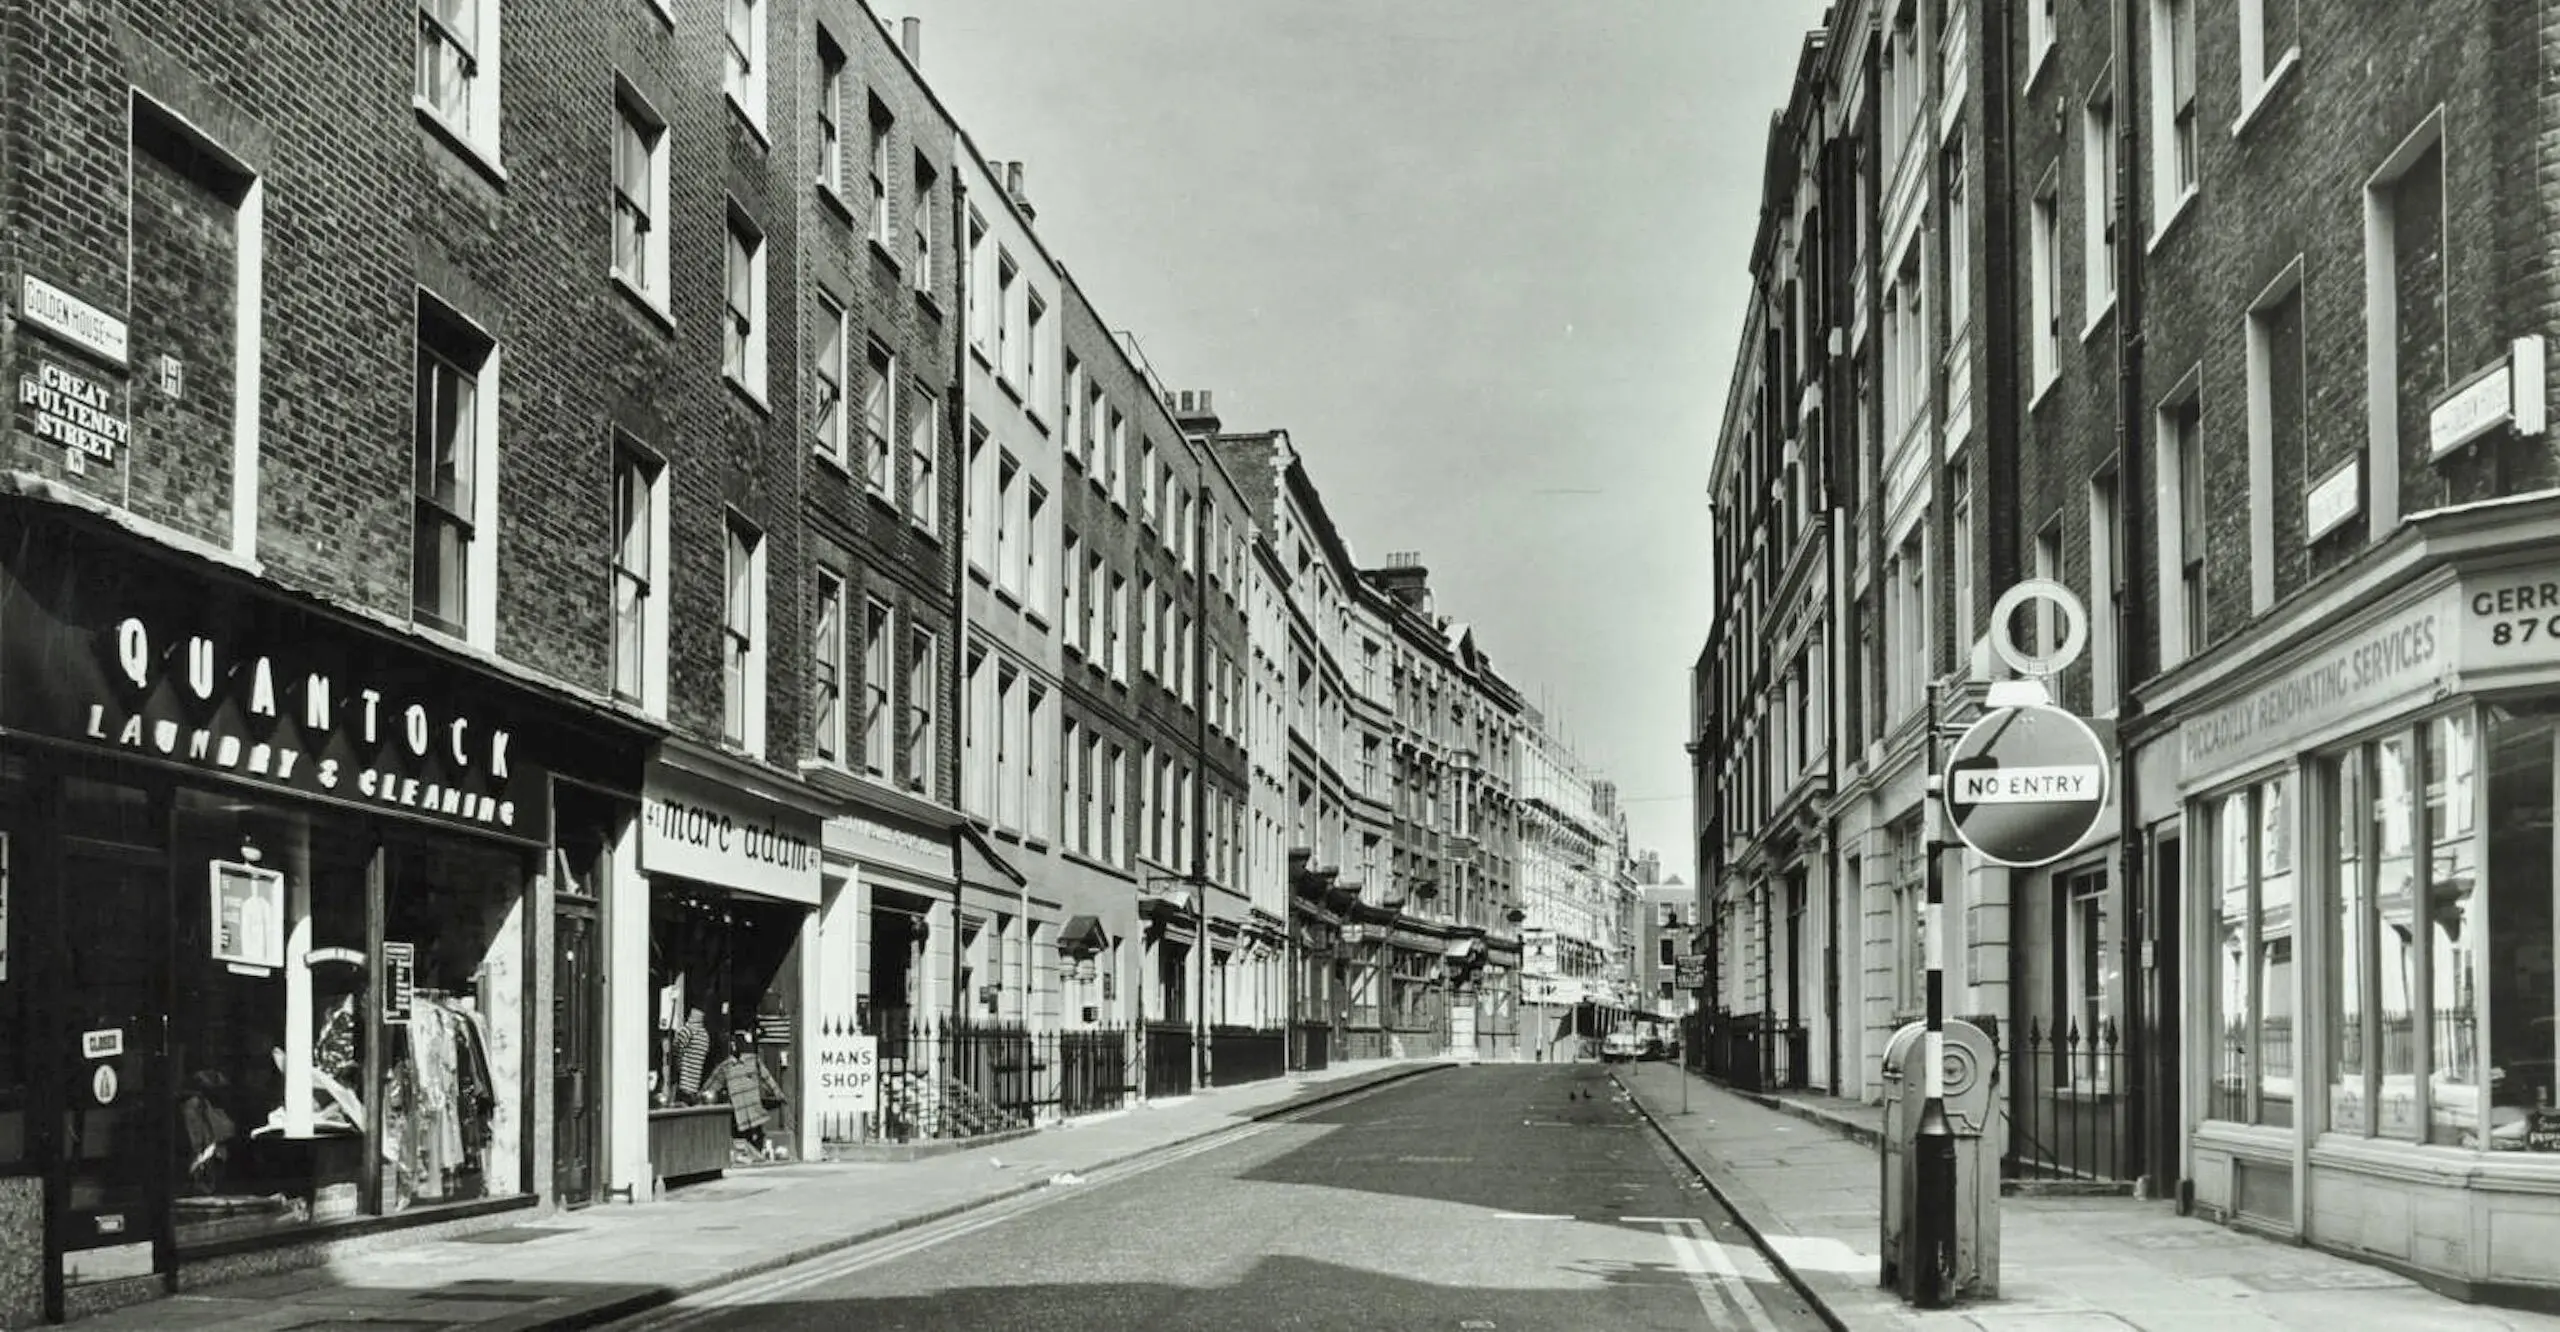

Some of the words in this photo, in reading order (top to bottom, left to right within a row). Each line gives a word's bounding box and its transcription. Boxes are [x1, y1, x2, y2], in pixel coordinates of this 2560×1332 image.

[27, 280, 69, 326] GOLDEN
[71, 303, 105, 345] HOUSE
[25, 379, 128, 444] PULTENEY
[45, 363, 110, 412] GREAT
[37, 409, 114, 461] STREET
[117, 617, 509, 779] QUANTOCK
[2185, 701, 2257, 764] PICCADILLY
[2258, 655, 2348, 731] RENOVATING
[2350, 615, 2436, 691] SERVICES
[86, 704, 299, 779] LAUNDRY
[318, 758, 339, 789] &
[358, 768, 515, 828] CLEANING
[1967, 776, 2000, 797] NO
[2009, 775, 2085, 795] ENTRY
[663, 798, 732, 852] marc
[744, 814, 807, 872] adam
[821, 1050, 871, 1066] MANS
[821, 1072, 871, 1088] SHOP
